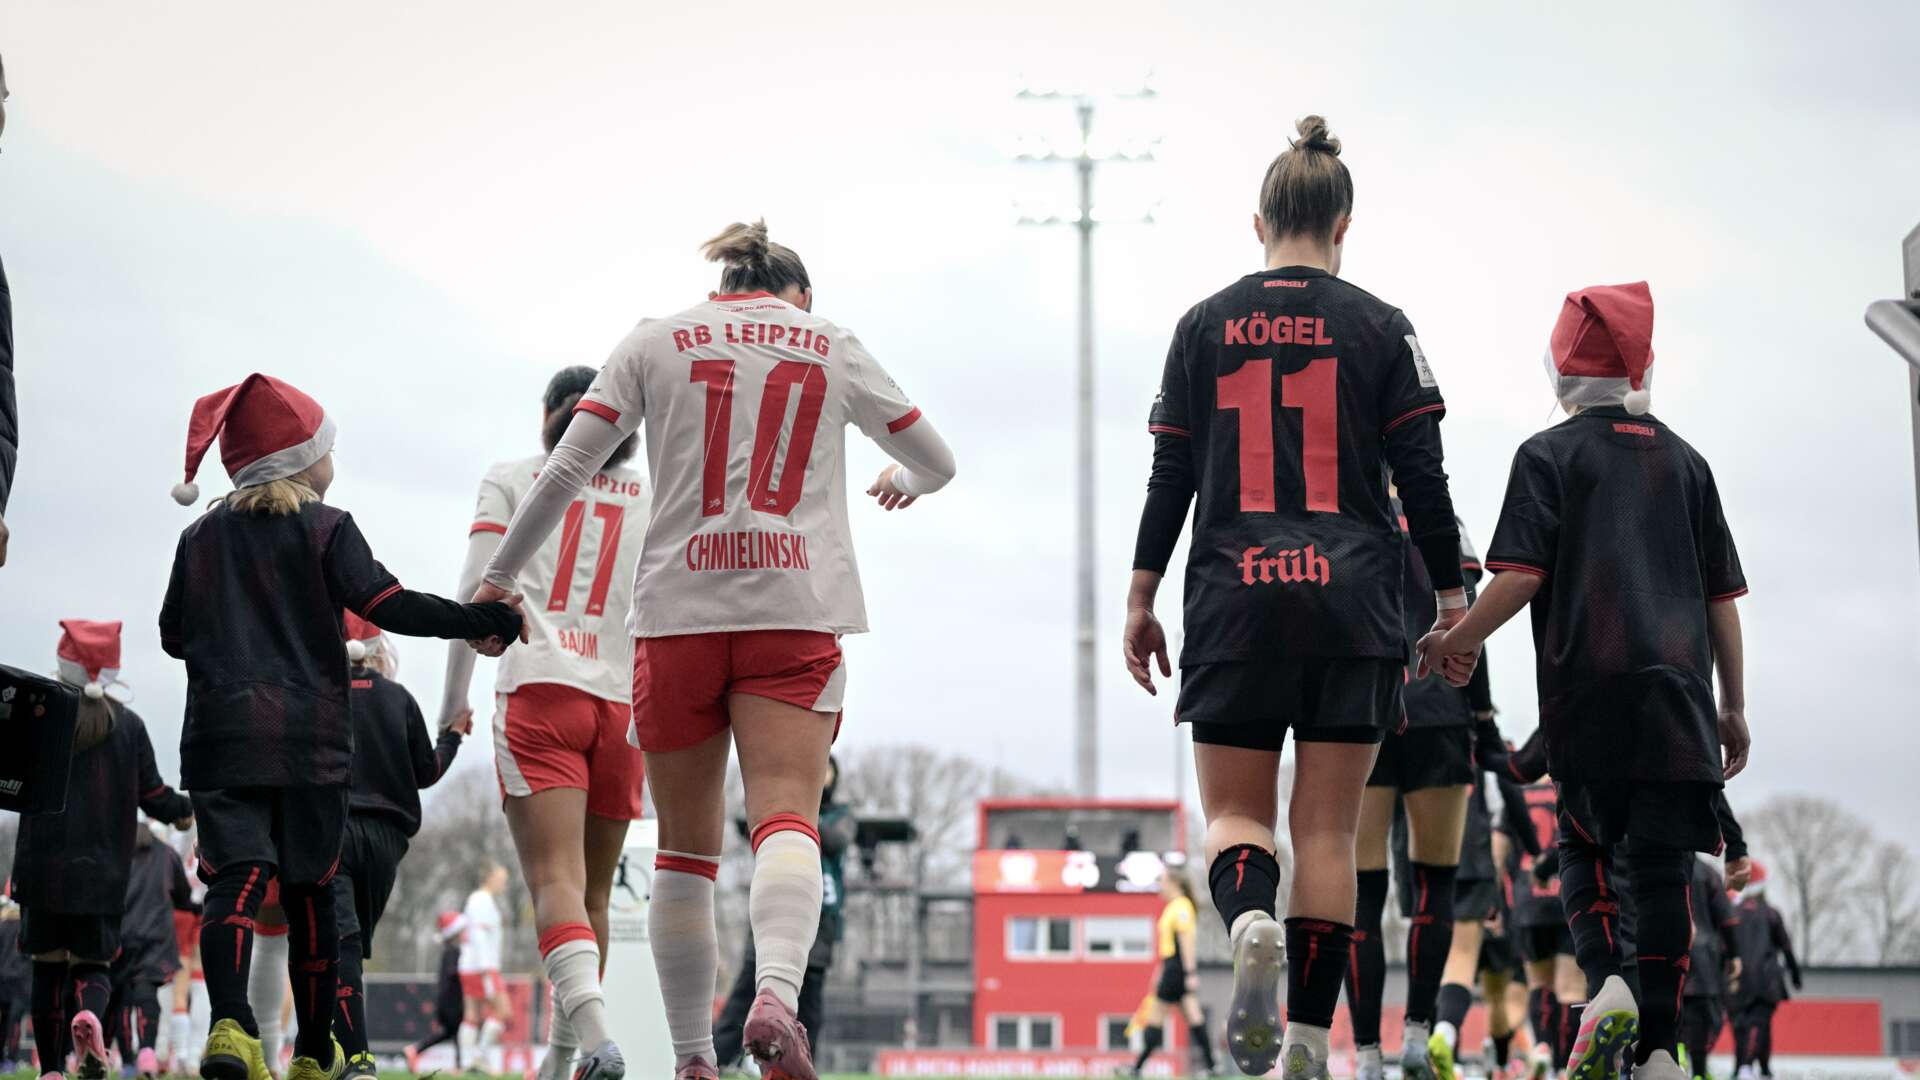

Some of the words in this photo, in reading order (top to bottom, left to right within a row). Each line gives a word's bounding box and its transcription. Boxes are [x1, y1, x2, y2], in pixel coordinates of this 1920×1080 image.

[672, 325, 712, 353] RB
[725, 323, 830, 357] LEIPZIG
[1224, 311, 1333, 346] KÖGEL
[689, 359, 828, 518] 10
[1216, 357, 1340, 514] 11
[547, 499, 625, 617] 11
[686, 531, 810, 571] CHMIELINSKI
[1237, 543, 1331, 587] früh
[558, 628, 599, 660] BAUM
